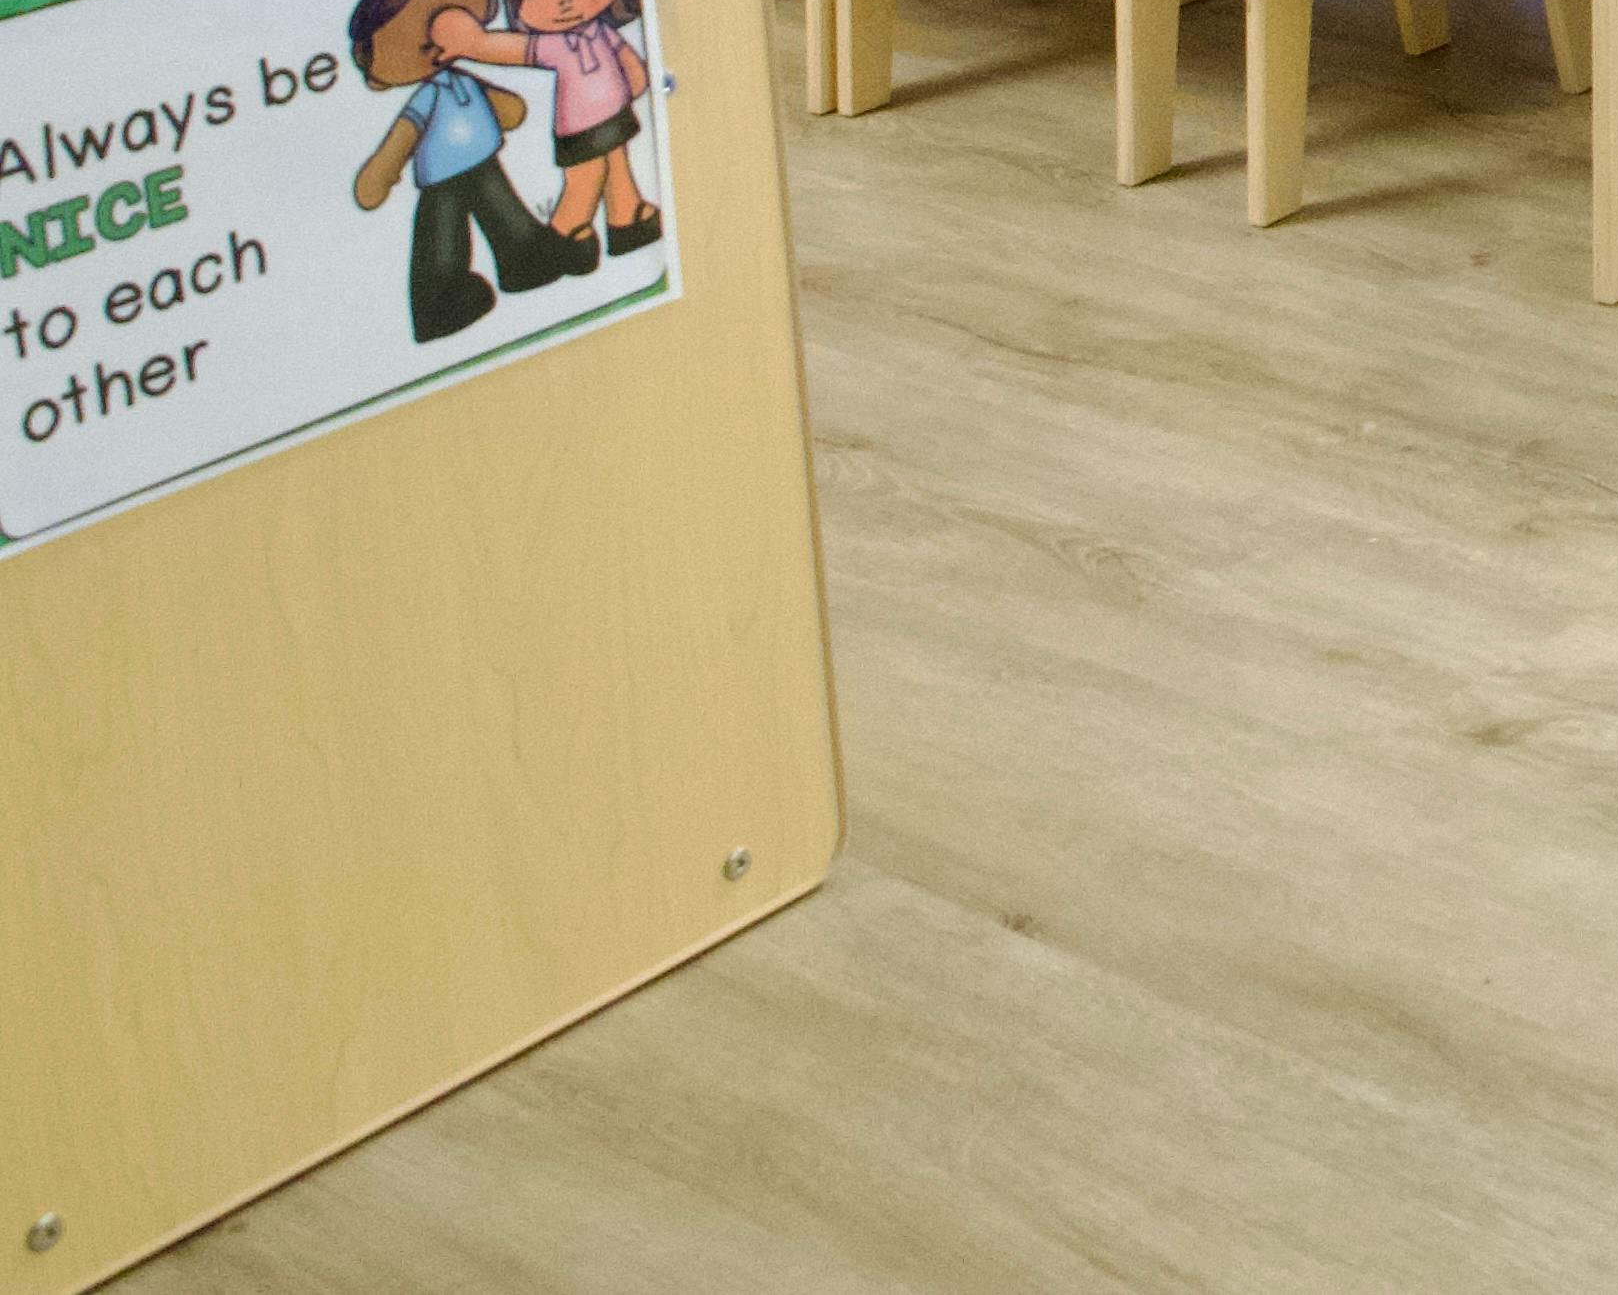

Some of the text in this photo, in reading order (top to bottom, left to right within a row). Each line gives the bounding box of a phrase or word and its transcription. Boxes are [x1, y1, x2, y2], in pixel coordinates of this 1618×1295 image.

[0, 52, 339, 185] Always be
[0, 164, 188, 279] NICE
[3, 230, 266, 359] to each
[22, 340, 208, 442] other
